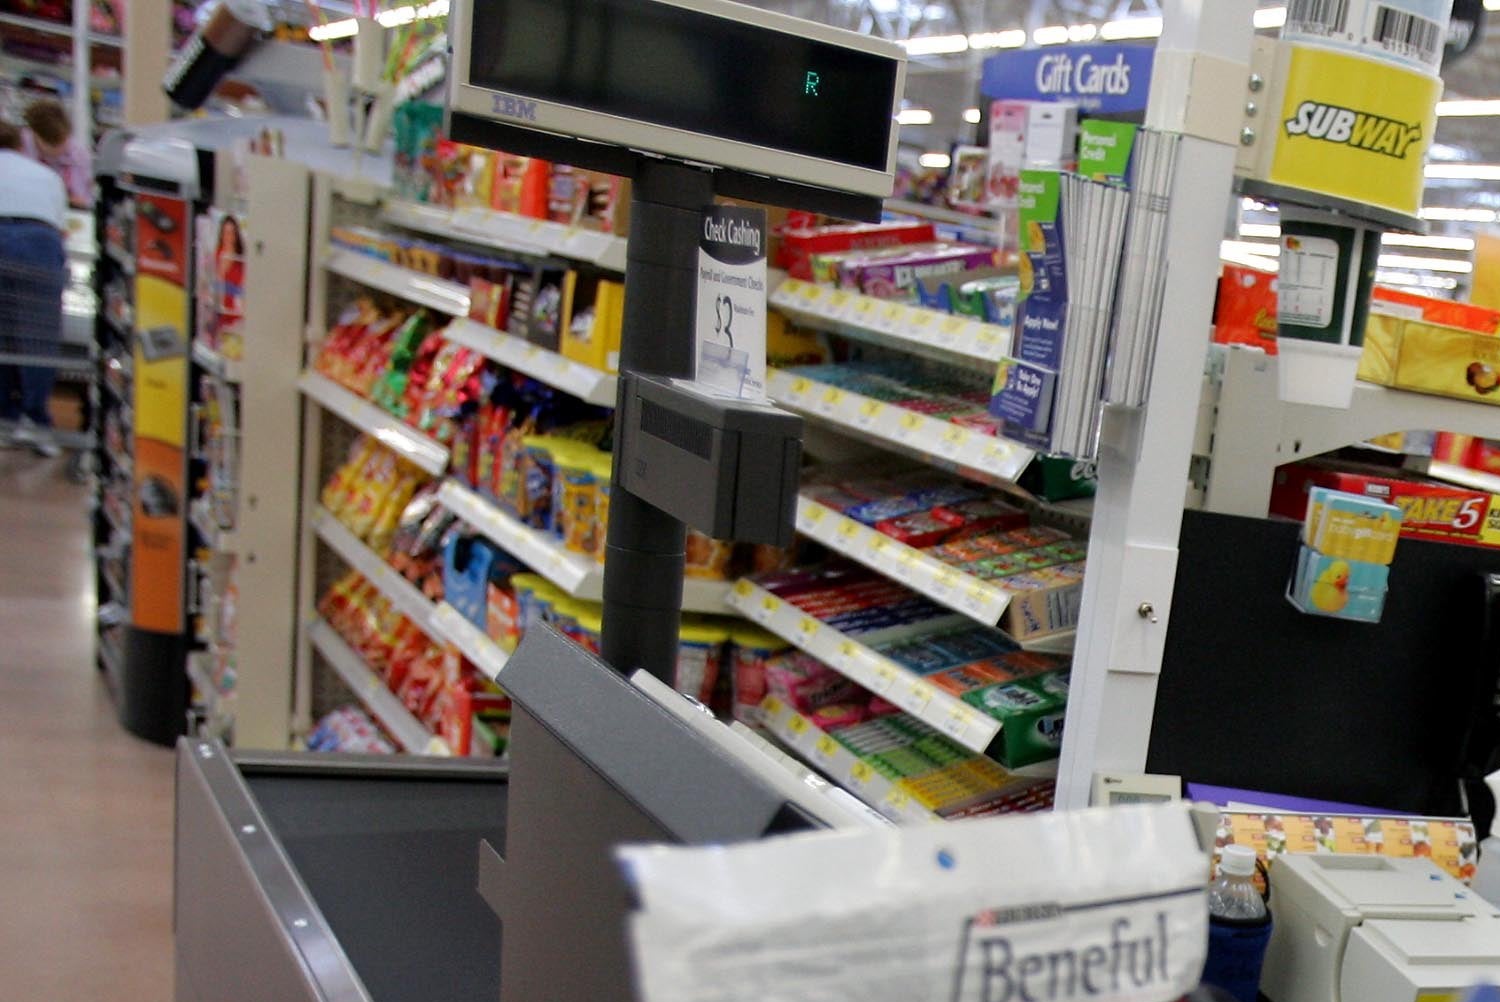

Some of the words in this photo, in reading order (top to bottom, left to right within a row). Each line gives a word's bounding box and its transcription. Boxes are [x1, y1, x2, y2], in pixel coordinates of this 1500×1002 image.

[804, 70, 820, 96] R
[1035, 53, 1073, 94] Gift
[1074, 53, 1131, 96] Cards
[492, 94, 537, 120] IBM
[1285, 100, 1422, 159] SUBWAY
[704, 216, 727, 242] Check
[727, 220, 761, 256] Cashing
[1452, 498, 1485, 529] 5
